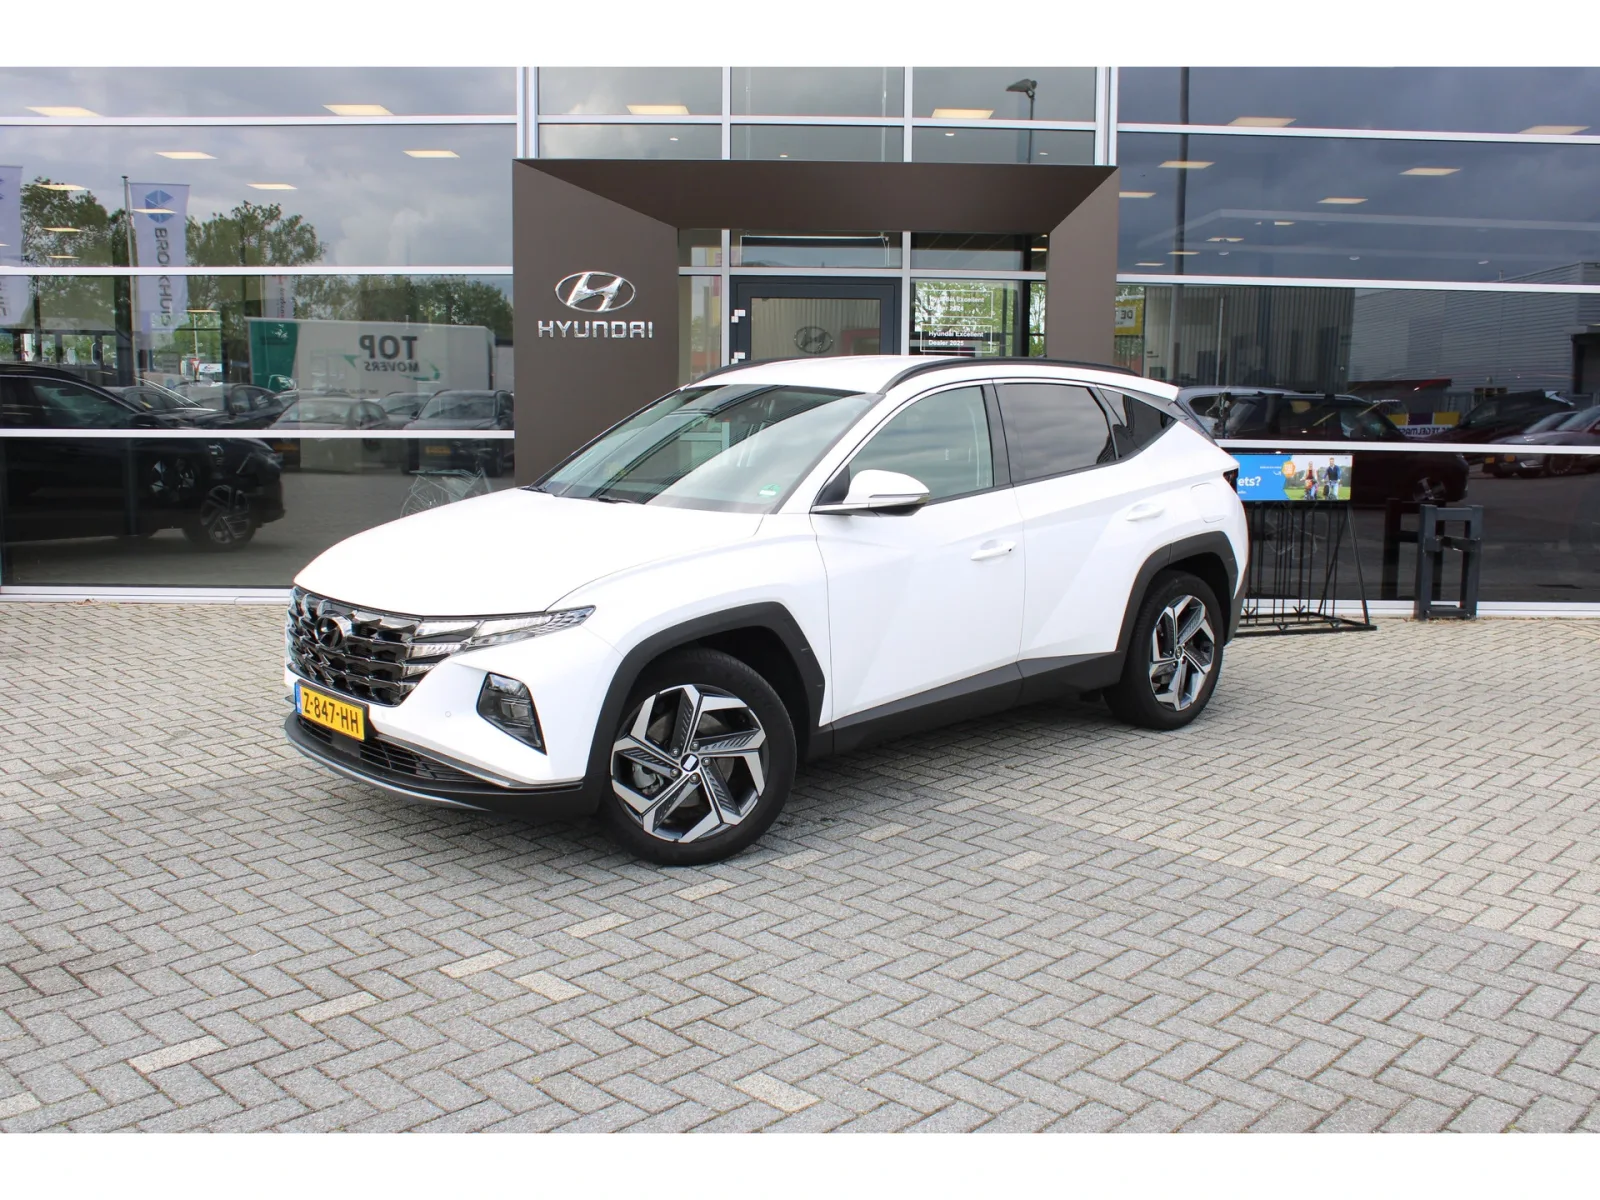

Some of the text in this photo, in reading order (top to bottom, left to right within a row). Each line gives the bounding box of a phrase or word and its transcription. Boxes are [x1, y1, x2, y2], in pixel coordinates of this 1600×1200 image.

[155, 227, 172, 327] BROKHUIS
[537, 320, 653, 339] HYUNDAI
[928, 330, 954, 338] Hyundai
[949, 339, 965, 347] 2025
[303, 691, 359, 734] Z-847-HH
